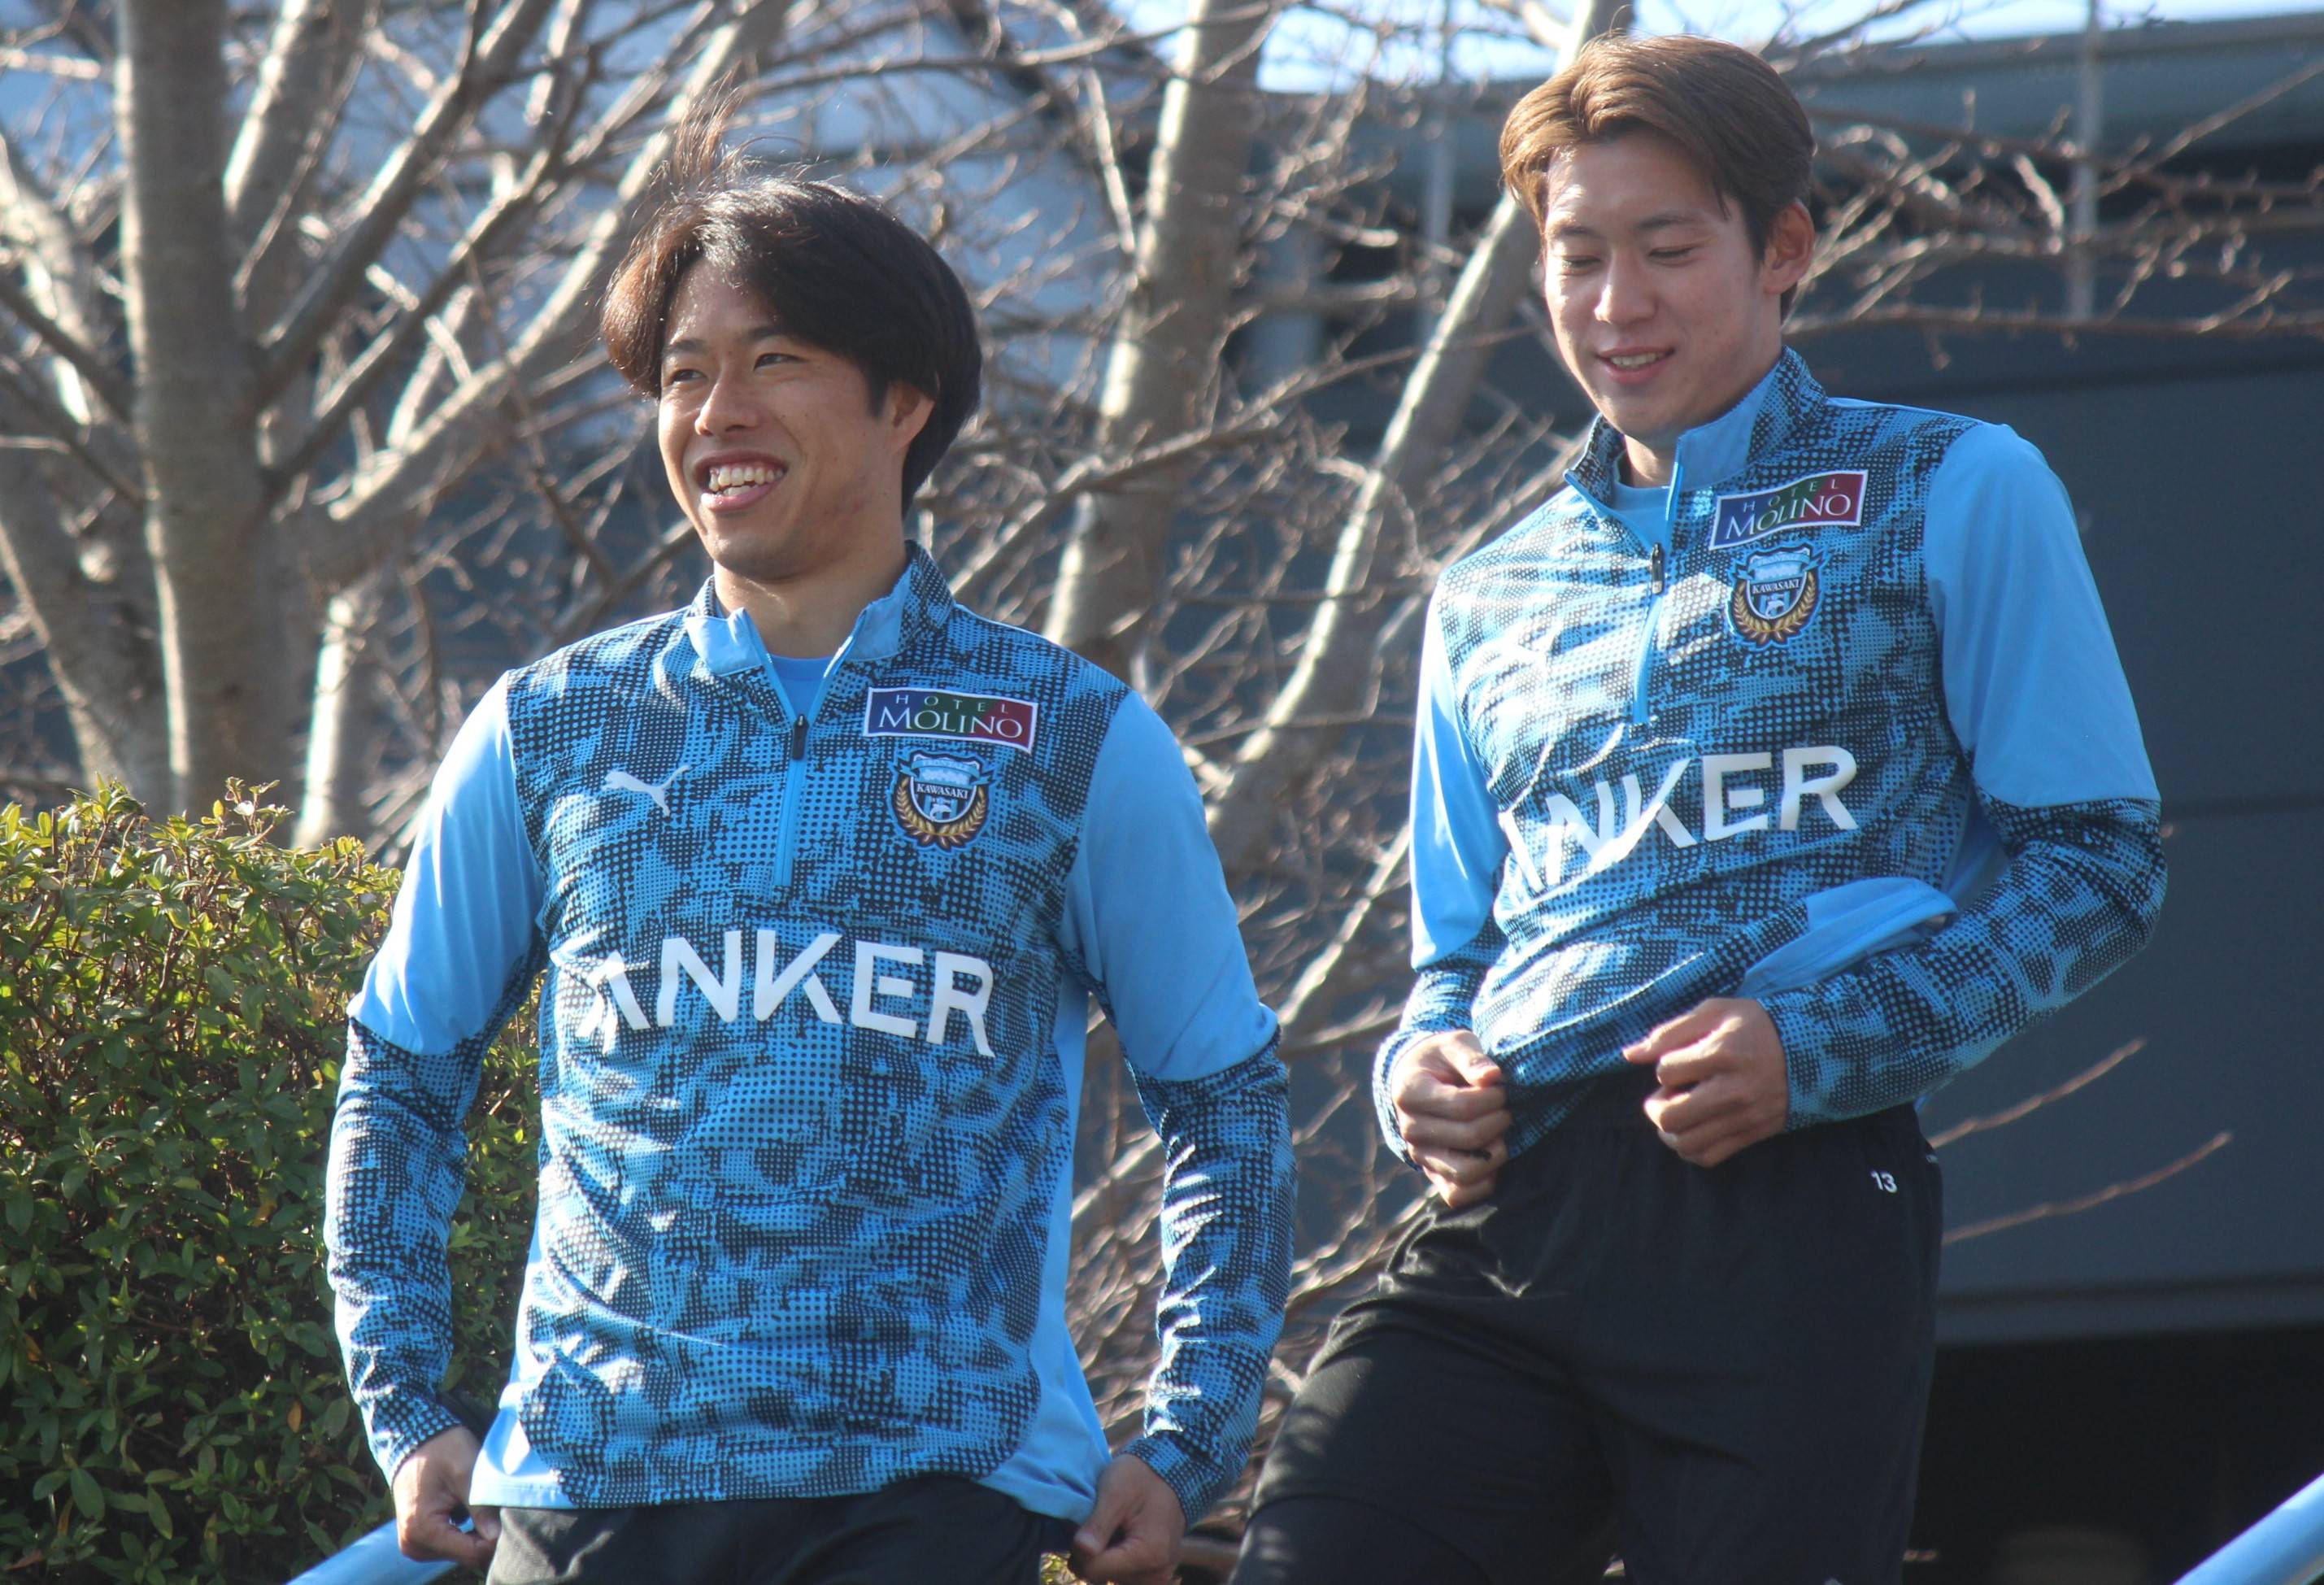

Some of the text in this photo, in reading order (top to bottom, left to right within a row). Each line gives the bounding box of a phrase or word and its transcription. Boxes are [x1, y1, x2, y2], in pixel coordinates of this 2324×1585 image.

[1743, 479, 1839, 512] HOTEL
[1726, 494, 1852, 540] MOLINO
[1752, 579, 1800, 594] KAWASAKI
[896, 695, 1008, 714] HOTEL
[878, 706, 1023, 738] MOLINO
[916, 783, 969, 799] KAWASAKI
[575, 930, 996, 1057] ANKER
[1871, 1170, 1898, 1193] 13
